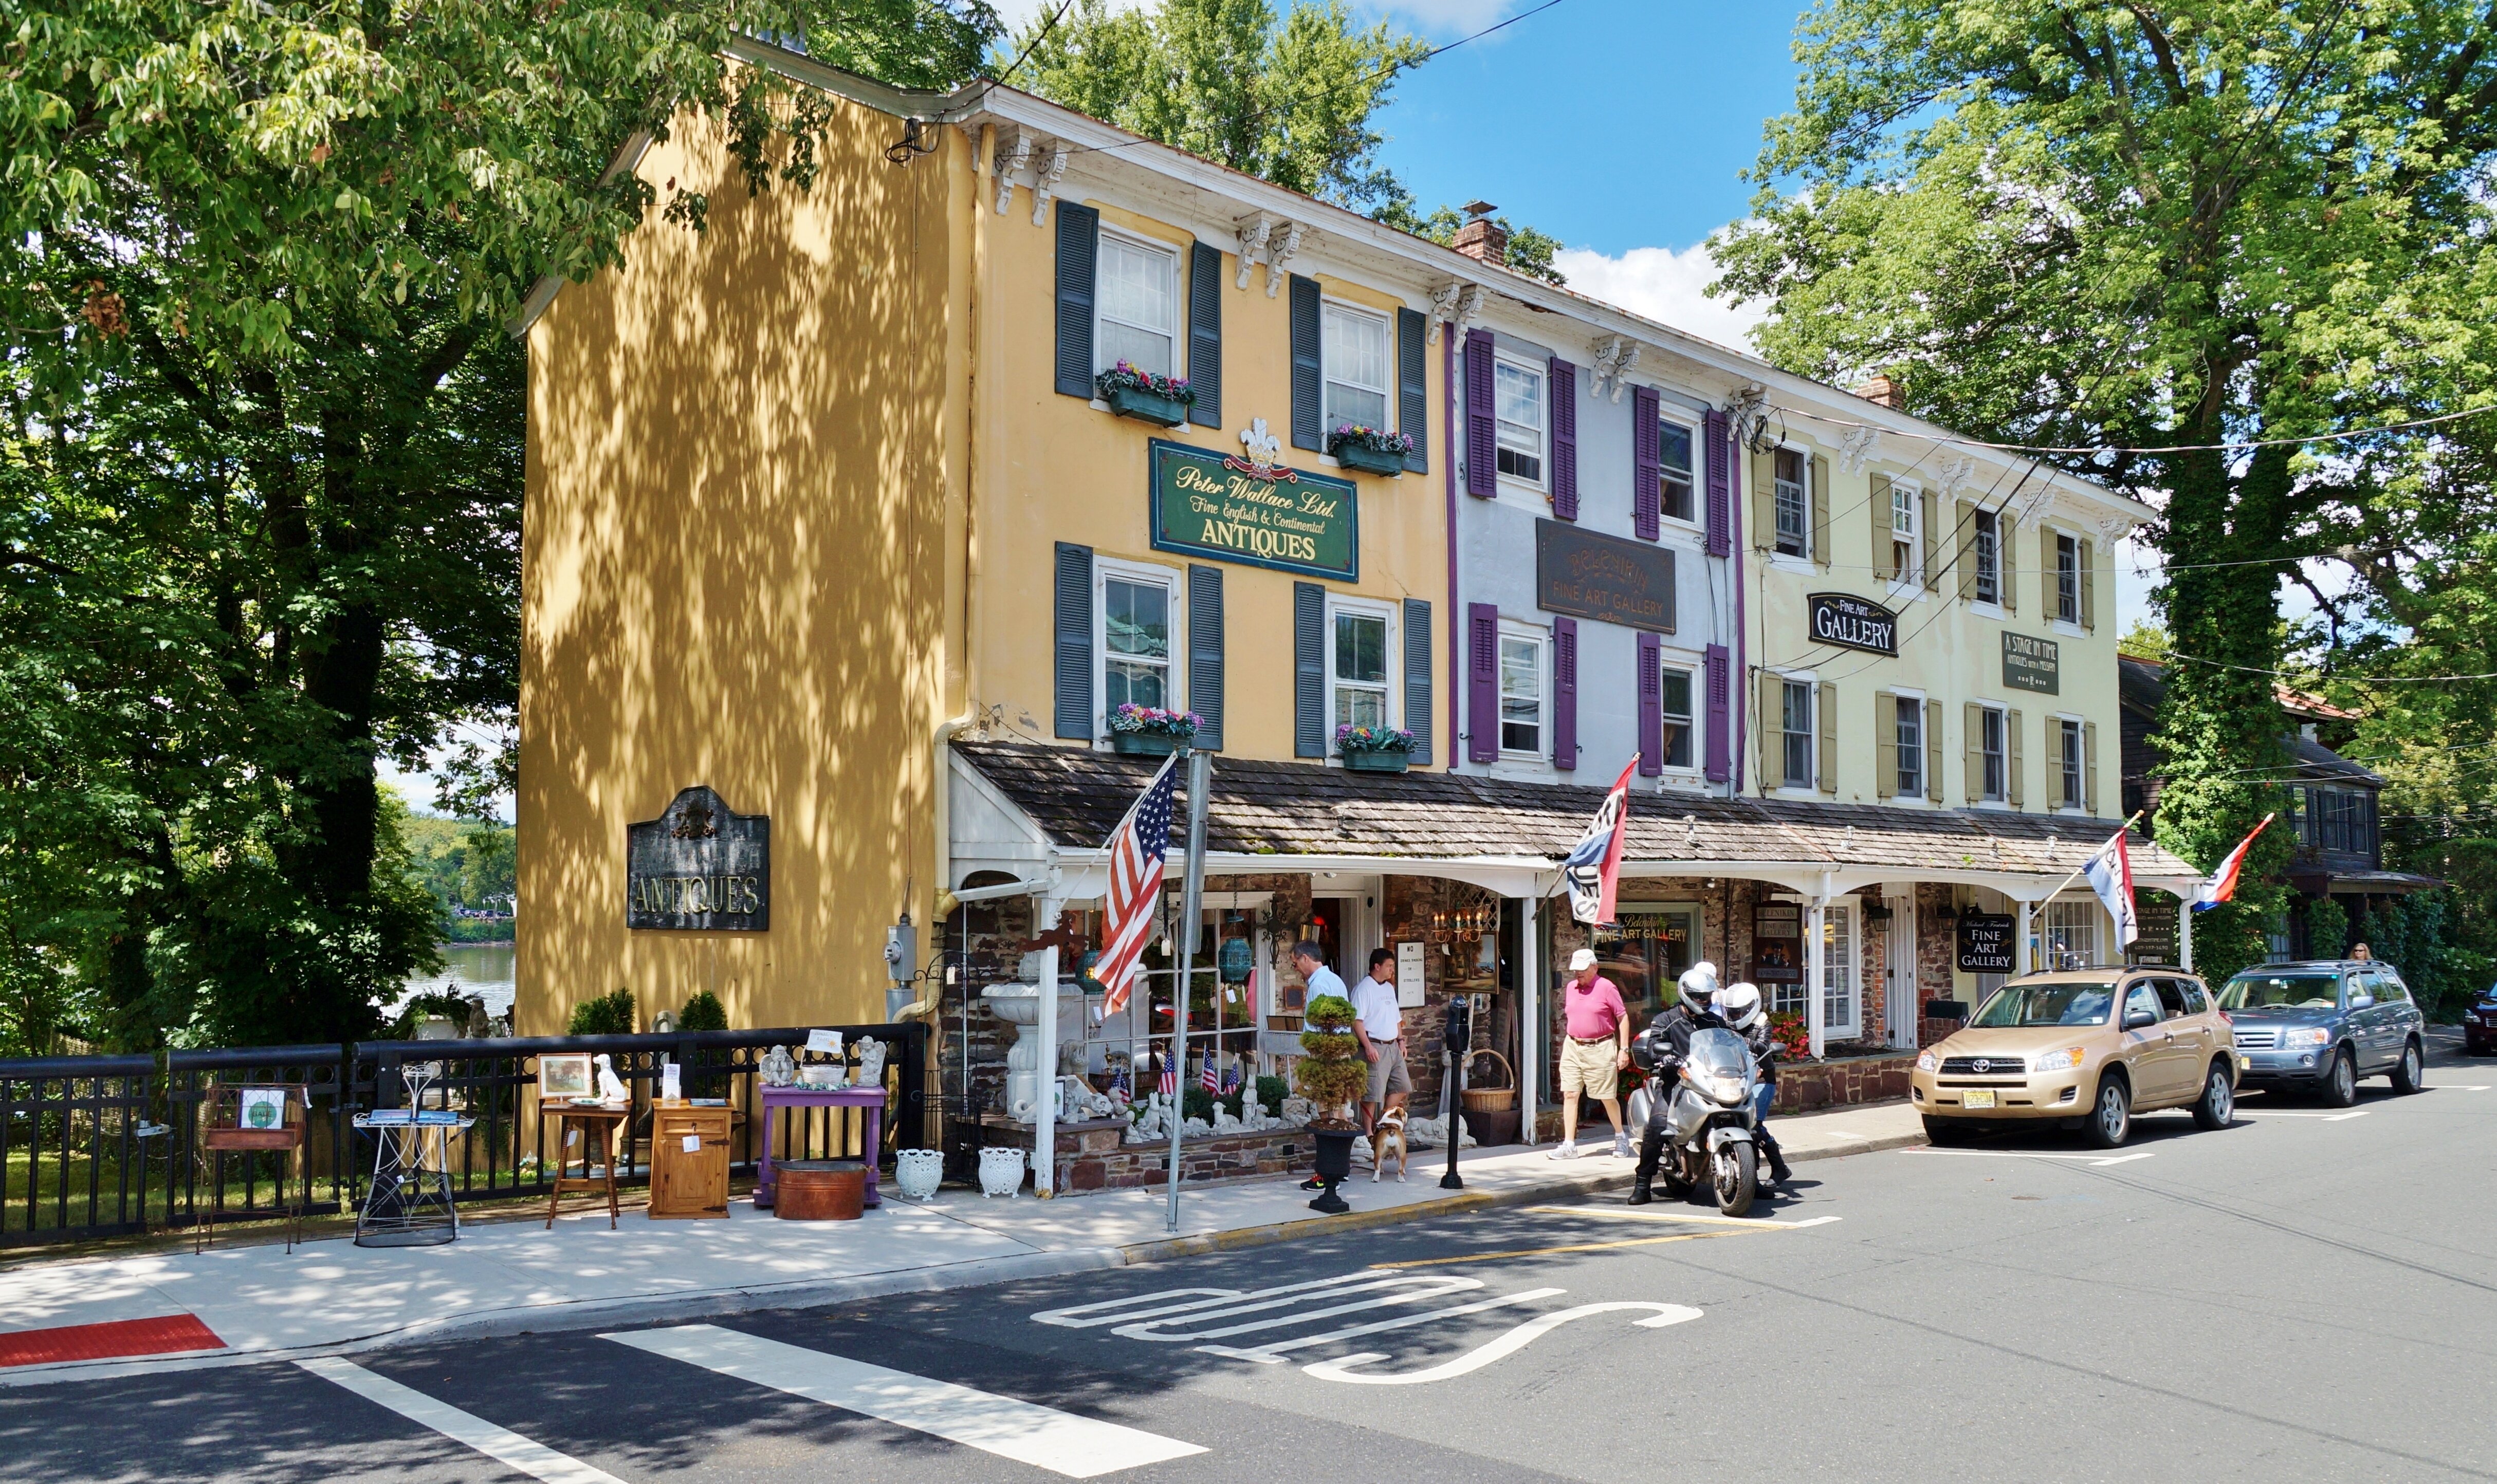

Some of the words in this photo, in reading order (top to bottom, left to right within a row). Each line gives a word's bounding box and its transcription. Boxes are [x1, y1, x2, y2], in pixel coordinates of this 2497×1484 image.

[1176, 466, 1224, 495] Peter
[1226, 475, 1294, 509] Wallace
[1296, 492, 1337, 518] Ltd.
[1189, 495, 1219, 514] Fine
[1223, 499, 1258, 524] English
[1261, 511, 1271, 525] &
[1273, 508, 1326, 534] Continental
[1201, 518, 1316, 561] ANTIQUES
[1553, 581, 1579, 601] FINE
[1585, 588, 1608, 606] ART
[1613, 593, 1664, 617] GALLERY
[1840, 600, 1855, 614] FINE
[1855, 603, 1868, 616] ART
[1817, 607, 1892, 649] GALLERY
[2006, 635, 2011, 651] A
[2012, 636, 2032, 655] STAGE
[2033, 641, 2040, 657] IN
[2042, 643, 2056, 660] TIME
[2007, 654, 2027, 667] ANTIQUES
[633, 876, 758, 914] ANTIQUES
[1594, 930, 1619, 944] FINE
[1621, 929, 1641, 940] ART
[1643, 929, 1686, 943] GALLERY
[1972, 930, 2000, 940] FINE
[1974, 942, 1998, 953] ART
[1961, 955, 2011, 967] GALLERY
[1030, 1269, 1704, 1385] STOP
